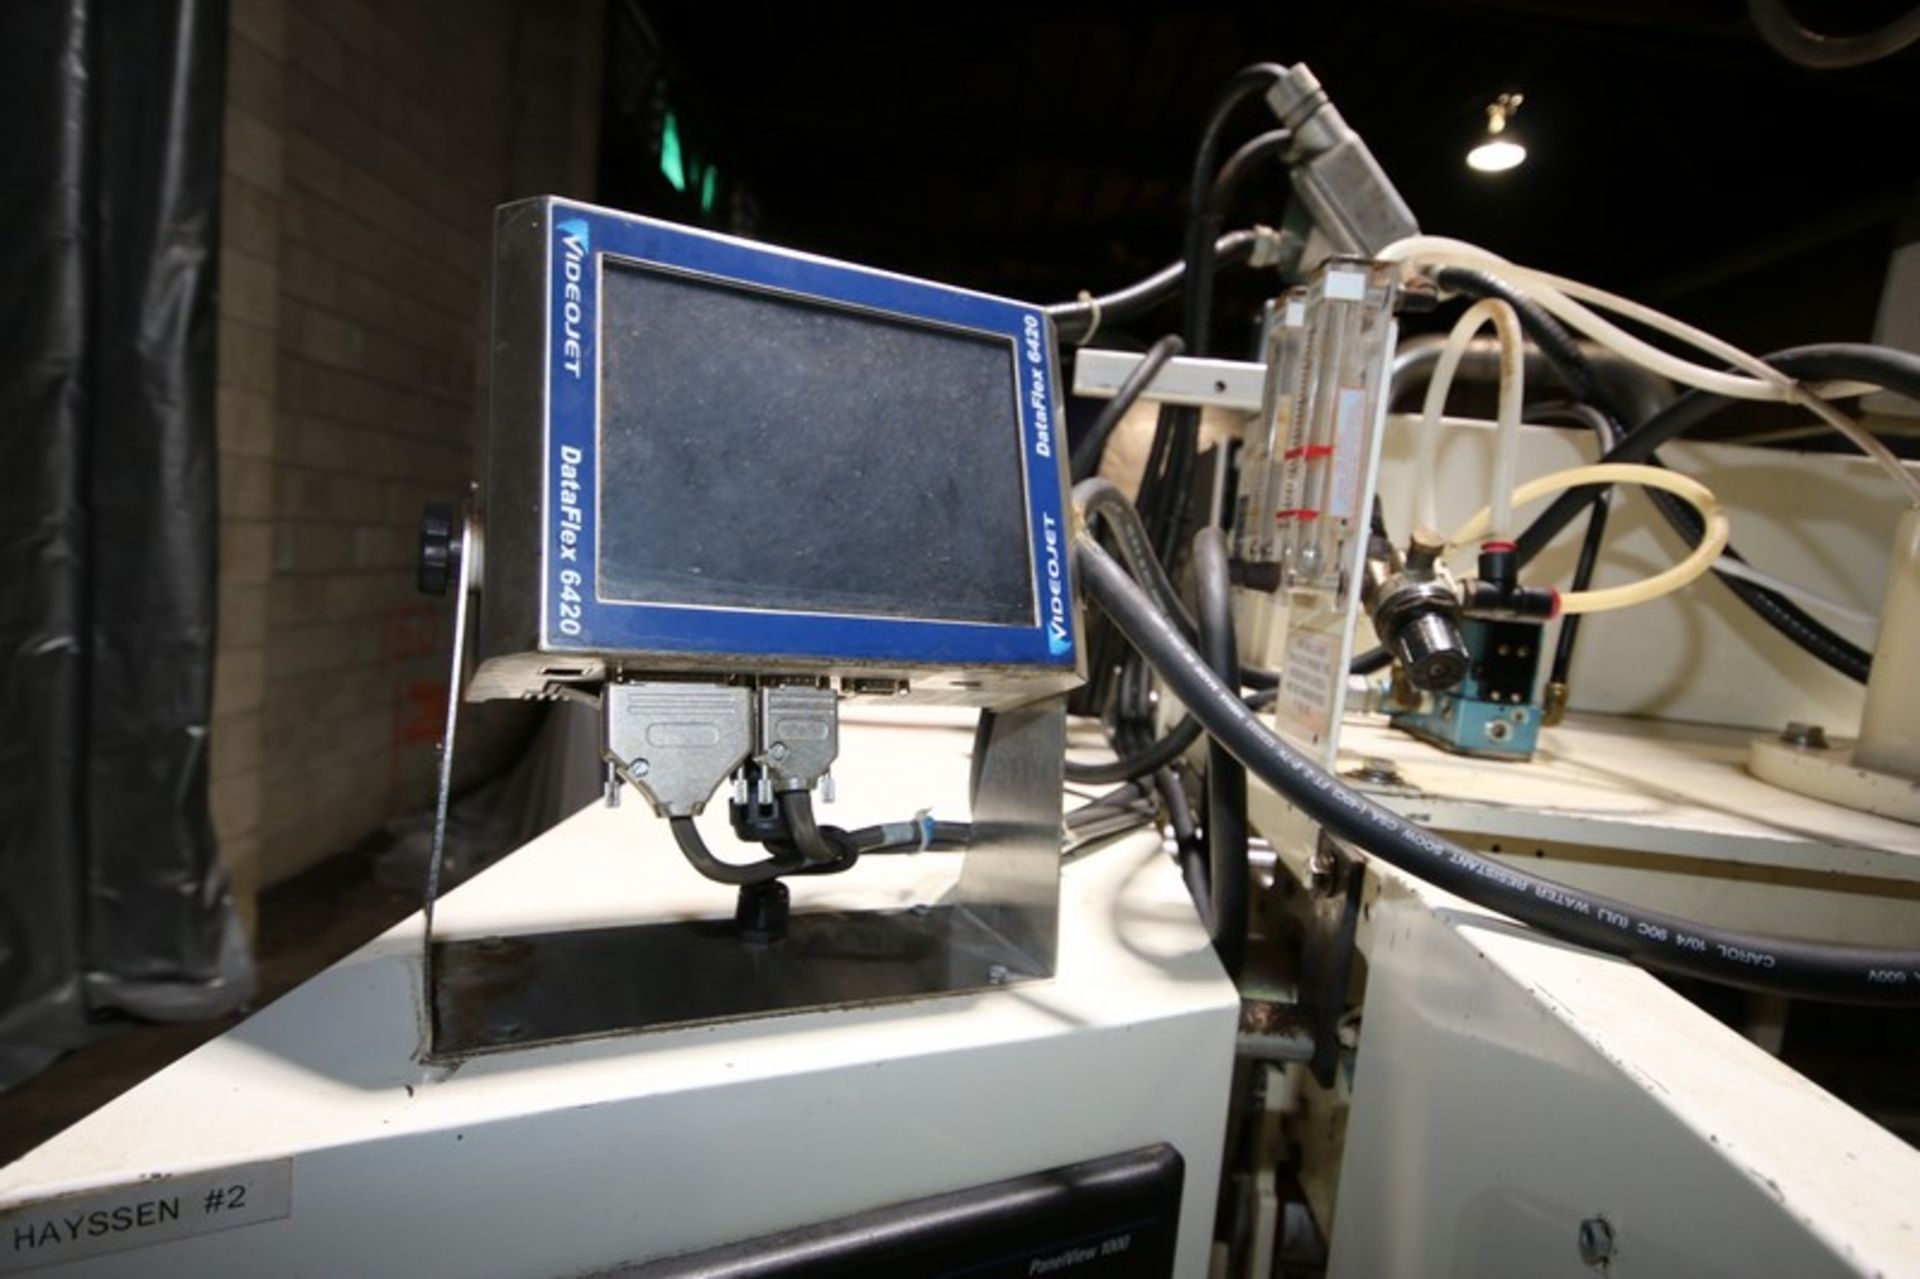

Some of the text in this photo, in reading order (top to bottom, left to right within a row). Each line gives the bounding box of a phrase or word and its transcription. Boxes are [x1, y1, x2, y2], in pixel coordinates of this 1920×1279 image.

[562, 234, 584, 379] VIDEOJET
[1023, 314, 1051, 457] DataFlex 6420
[559, 445, 582, 636] DataFlex 6420
[1043, 511, 1067, 640] VIDEOJET
[1371, 812, 1399, 832] CSA
[1450, 853, 1528, 892] RESISTANT
[1535, 886, 1590, 915] WATER
[1597, 908, 1628, 929] (UL)
[1675, 935, 1707, 953] 10/4
[1717, 943, 1776, 968] CAROL
[14, 1185, 247, 1251] HAYSSEN #2
